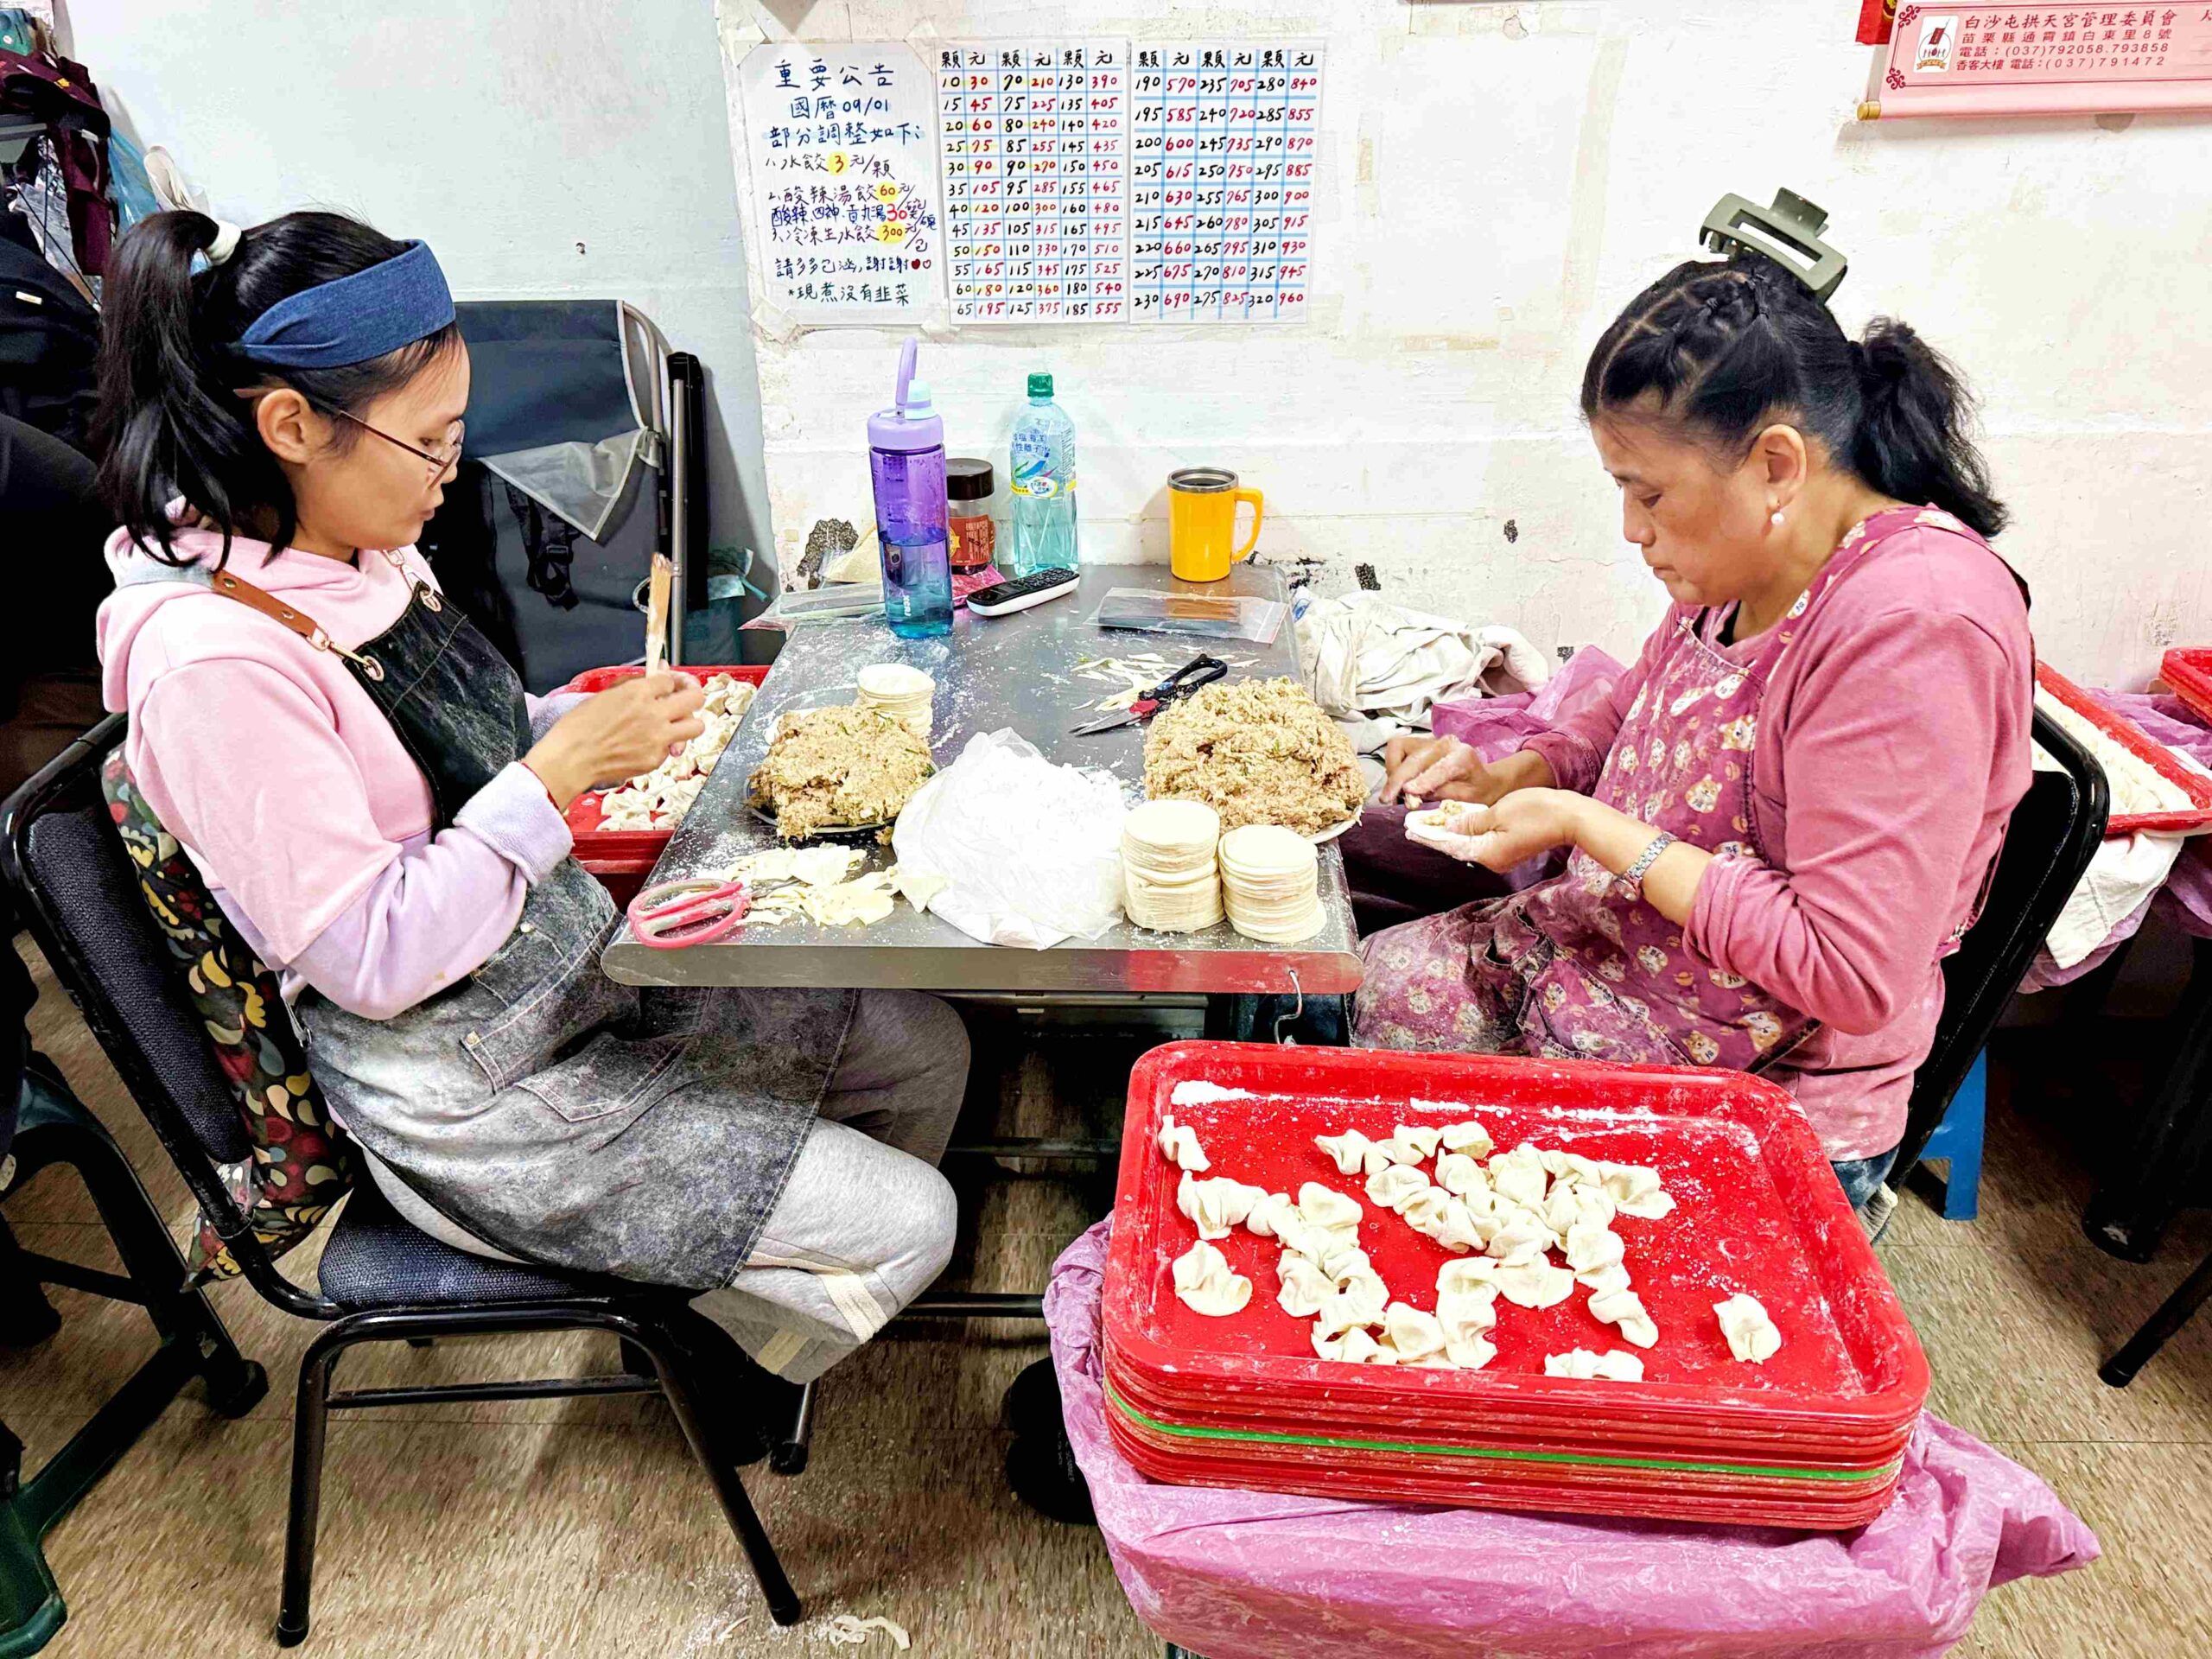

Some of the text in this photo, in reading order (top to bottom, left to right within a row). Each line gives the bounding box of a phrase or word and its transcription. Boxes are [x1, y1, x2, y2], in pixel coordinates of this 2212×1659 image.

[1965, 10, 2177, 30] 白沙屯拱天宮管理委員會
[1961, 29, 2172, 44] 苗栗縣通霄鎮白東里8號
[941, 48, 1113, 69] 顆 元 顆 元 顆 元
[1138, 48, 1314, 69] 顆 元 顆 元 顆 元
[774, 58, 894, 92] 重要公告
[942, 73, 1118, 92] 10 30 70 210 130 390
[1135, 75, 1318, 94] 190 570 235 705 280 840
[944, 96, 1119, 112] 15 45 75 225 135 405
[1135, 106, 1314, 124] 195 585 240 720 285 855
[945, 118, 1117, 133] 20 60 80 240 140 420
[946, 138, 1119, 154] 25 75 85 255 145 435
[1135, 136, 1313, 153] 200 600 245 735 290 870
[948, 159, 1118, 177] 30 90 90 270 150 450
[1134, 162, 1313, 181] 205 615 250 750 295 885
[948, 179, 1120, 197] 35 105 95 285 155 465
[1135, 189, 1309, 206] 210 630 255 765 300 900
[949, 201, 1119, 219] 40 120 100 300 160 480
[951, 221, 1122, 238] 45 135 105 315 165 495
[1135, 214, 1308, 233] 215 645 260 780 305 915
[954, 244, 1117, 257] 50 150 110 330 170 510
[1135, 241, 1306, 256] 220 660 265 795 310 930
[955, 261, 1121, 276] 55 165 115 345 175 525
[1135, 263, 1306, 282] 225 675 270 810 315 945
[956, 282, 1122, 296] 60 180 120 360 180 540
[957, 302, 1122, 315] 65 195 125 375 185 555
[1134, 289, 1304, 310] 230 690 275 825 320 960
